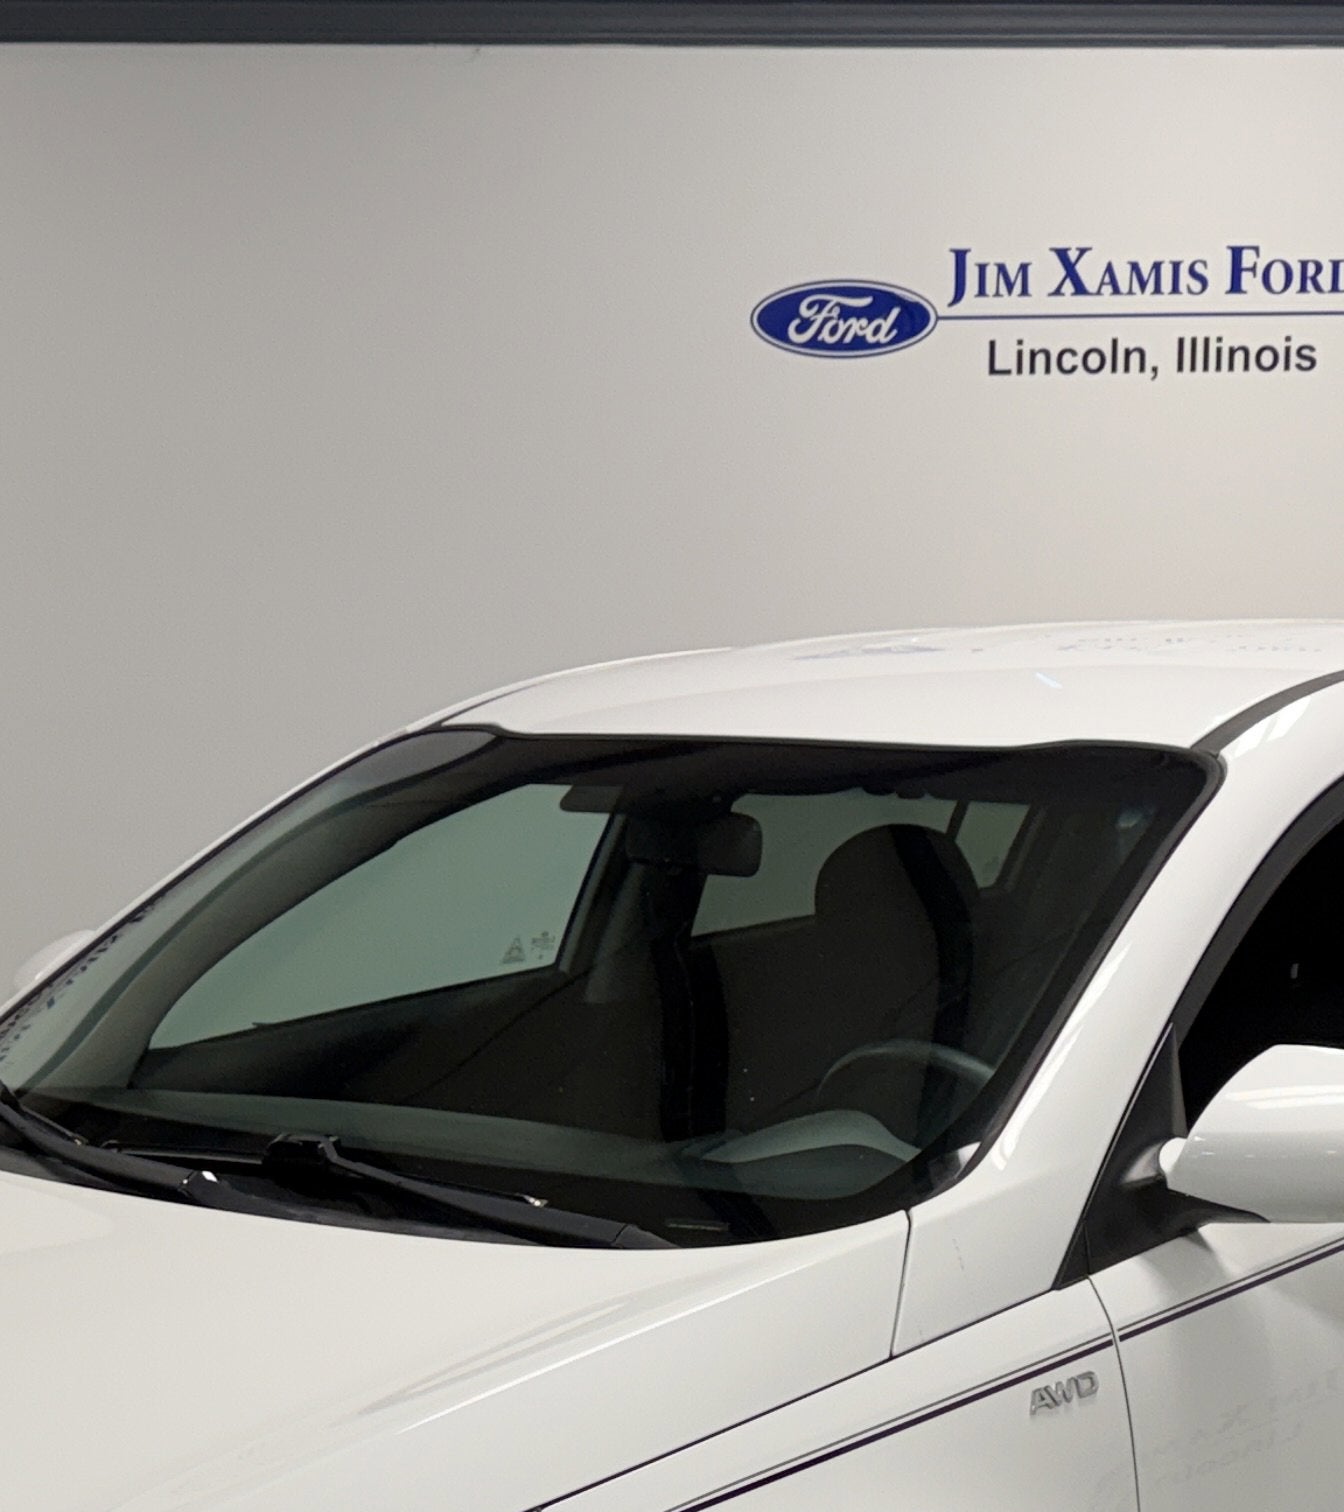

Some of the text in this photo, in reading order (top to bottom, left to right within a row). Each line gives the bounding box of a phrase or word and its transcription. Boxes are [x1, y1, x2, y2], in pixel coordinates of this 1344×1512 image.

[947, 248, 1033, 308] JIM
[1048, 246, 1209, 297] XAMIS
[787, 293, 898, 346] Ford
[987, 336, 1318, 380] Lincoln, Illinois
[1029, 1371, 1099, 1416] AWD
